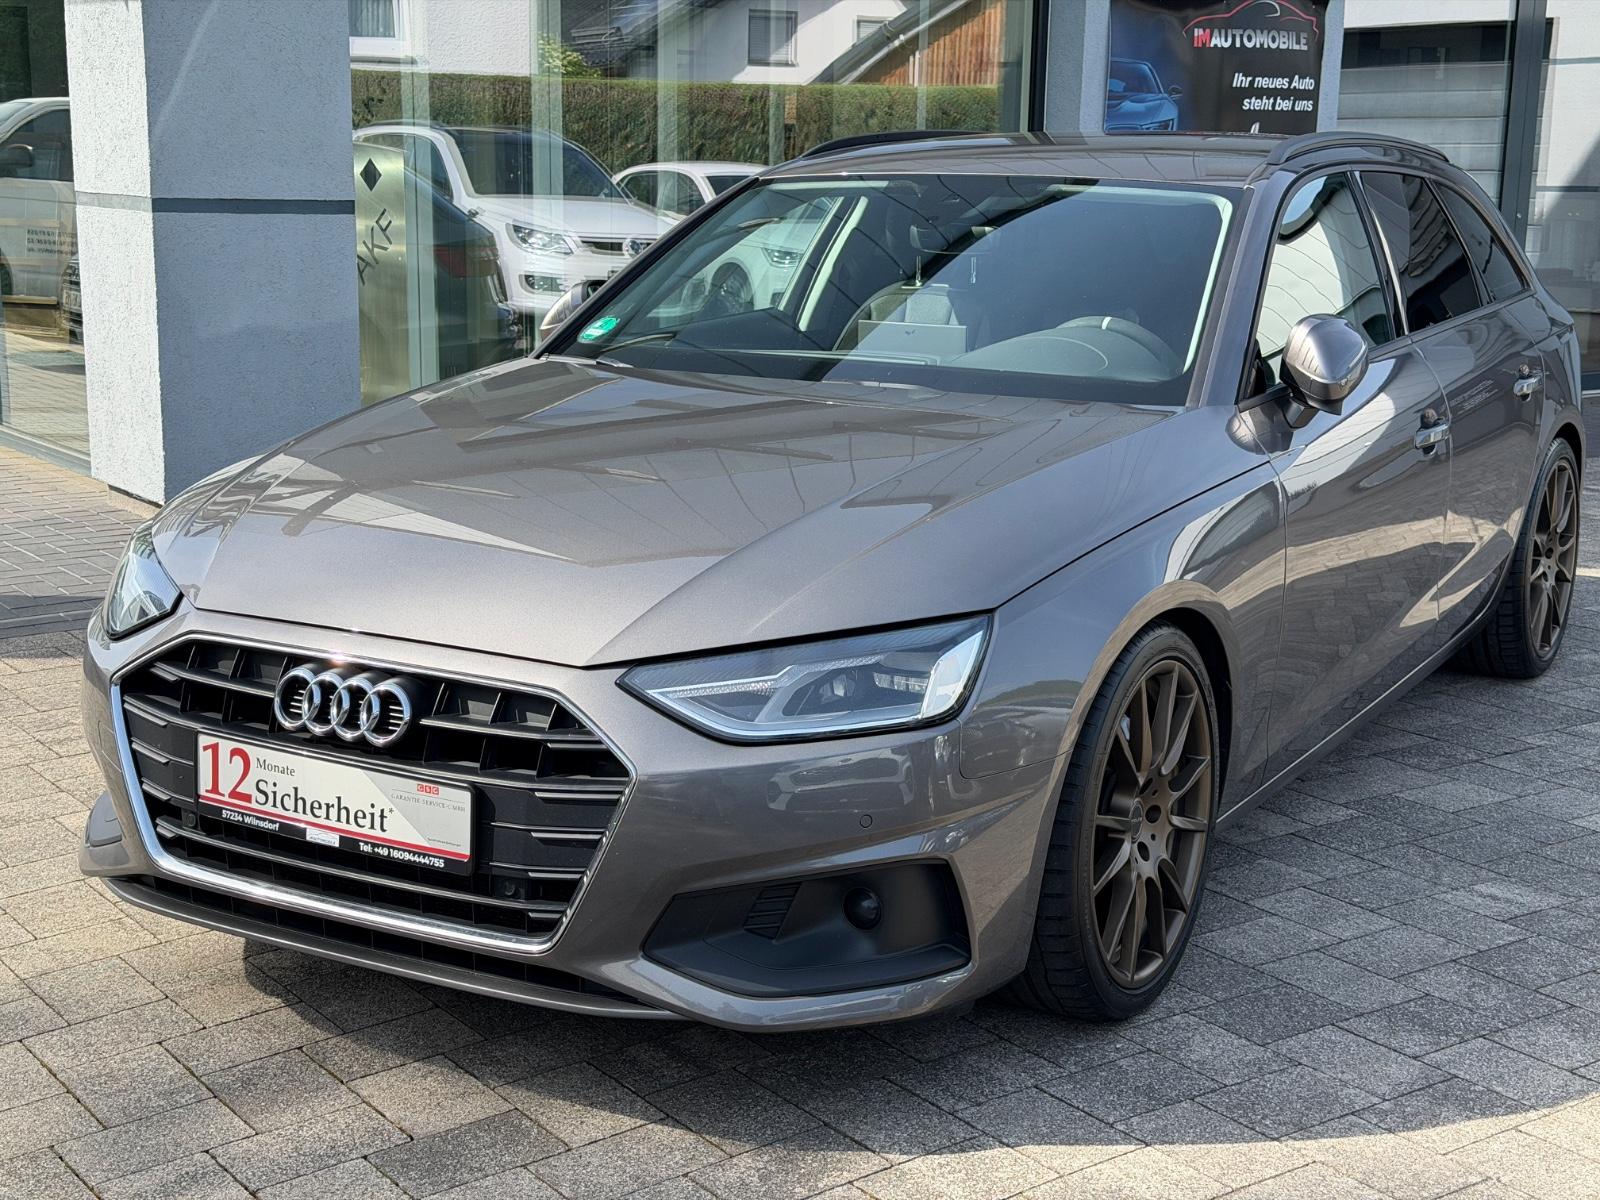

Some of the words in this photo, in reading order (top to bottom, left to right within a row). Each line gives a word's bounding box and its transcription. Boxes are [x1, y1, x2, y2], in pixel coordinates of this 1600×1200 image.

[1232, 72, 1252, 88] Ihr
[1254, 77, 1289, 90] neues
[1290, 75, 1315, 90] Auto
[1242, 96, 1274, 111] steht
[1275, 97, 1294, 111] bei
[1295, 99, 1314, 112] uns
[202, 741, 253, 804] 12
[255, 757, 296, 777] Monate
[221, 809, 243, 822] 57234
[374, 846, 389, 856] +49
